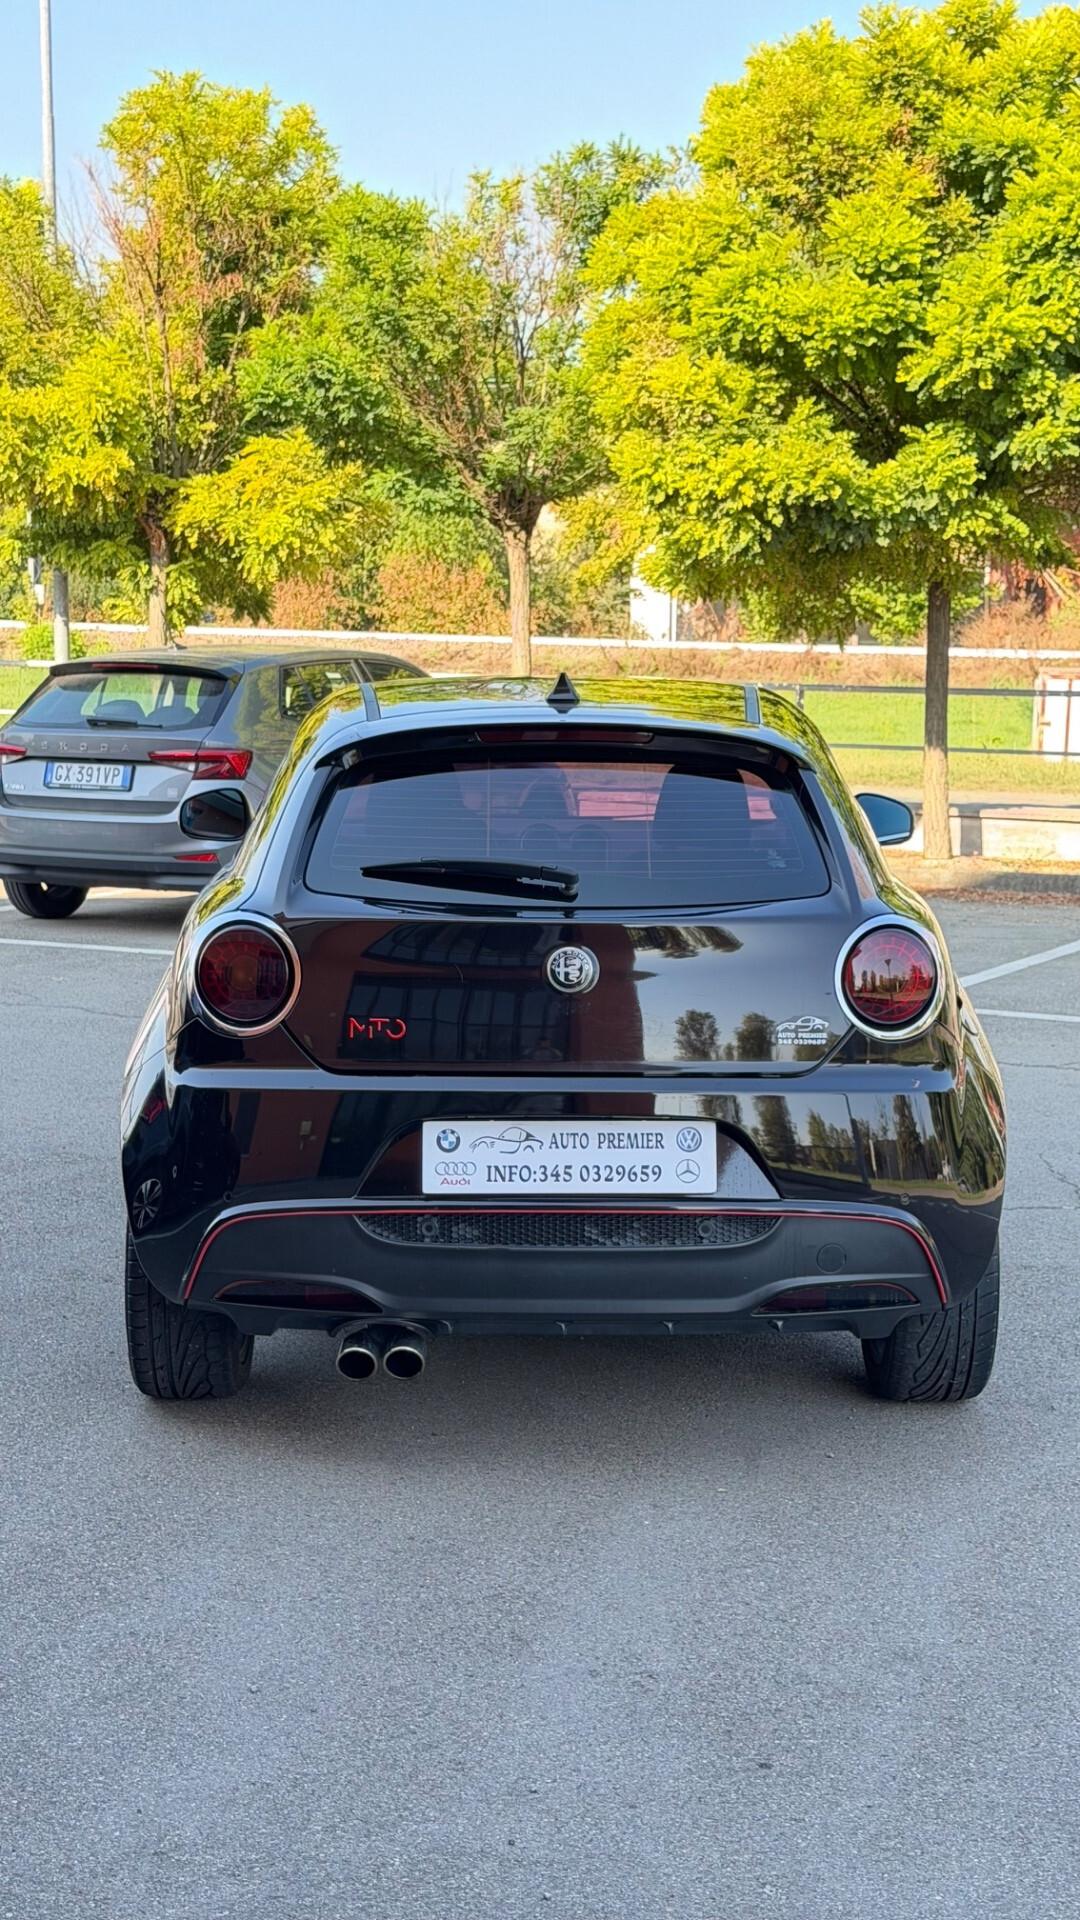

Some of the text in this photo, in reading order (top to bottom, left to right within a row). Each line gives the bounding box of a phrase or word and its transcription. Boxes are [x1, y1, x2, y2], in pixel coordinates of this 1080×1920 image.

[55, 764, 120, 784] GX 391VP
[549, 1132, 665, 1150] AUTO PREMIER
[486, 1164, 662, 1183] INFO:345 0329659
